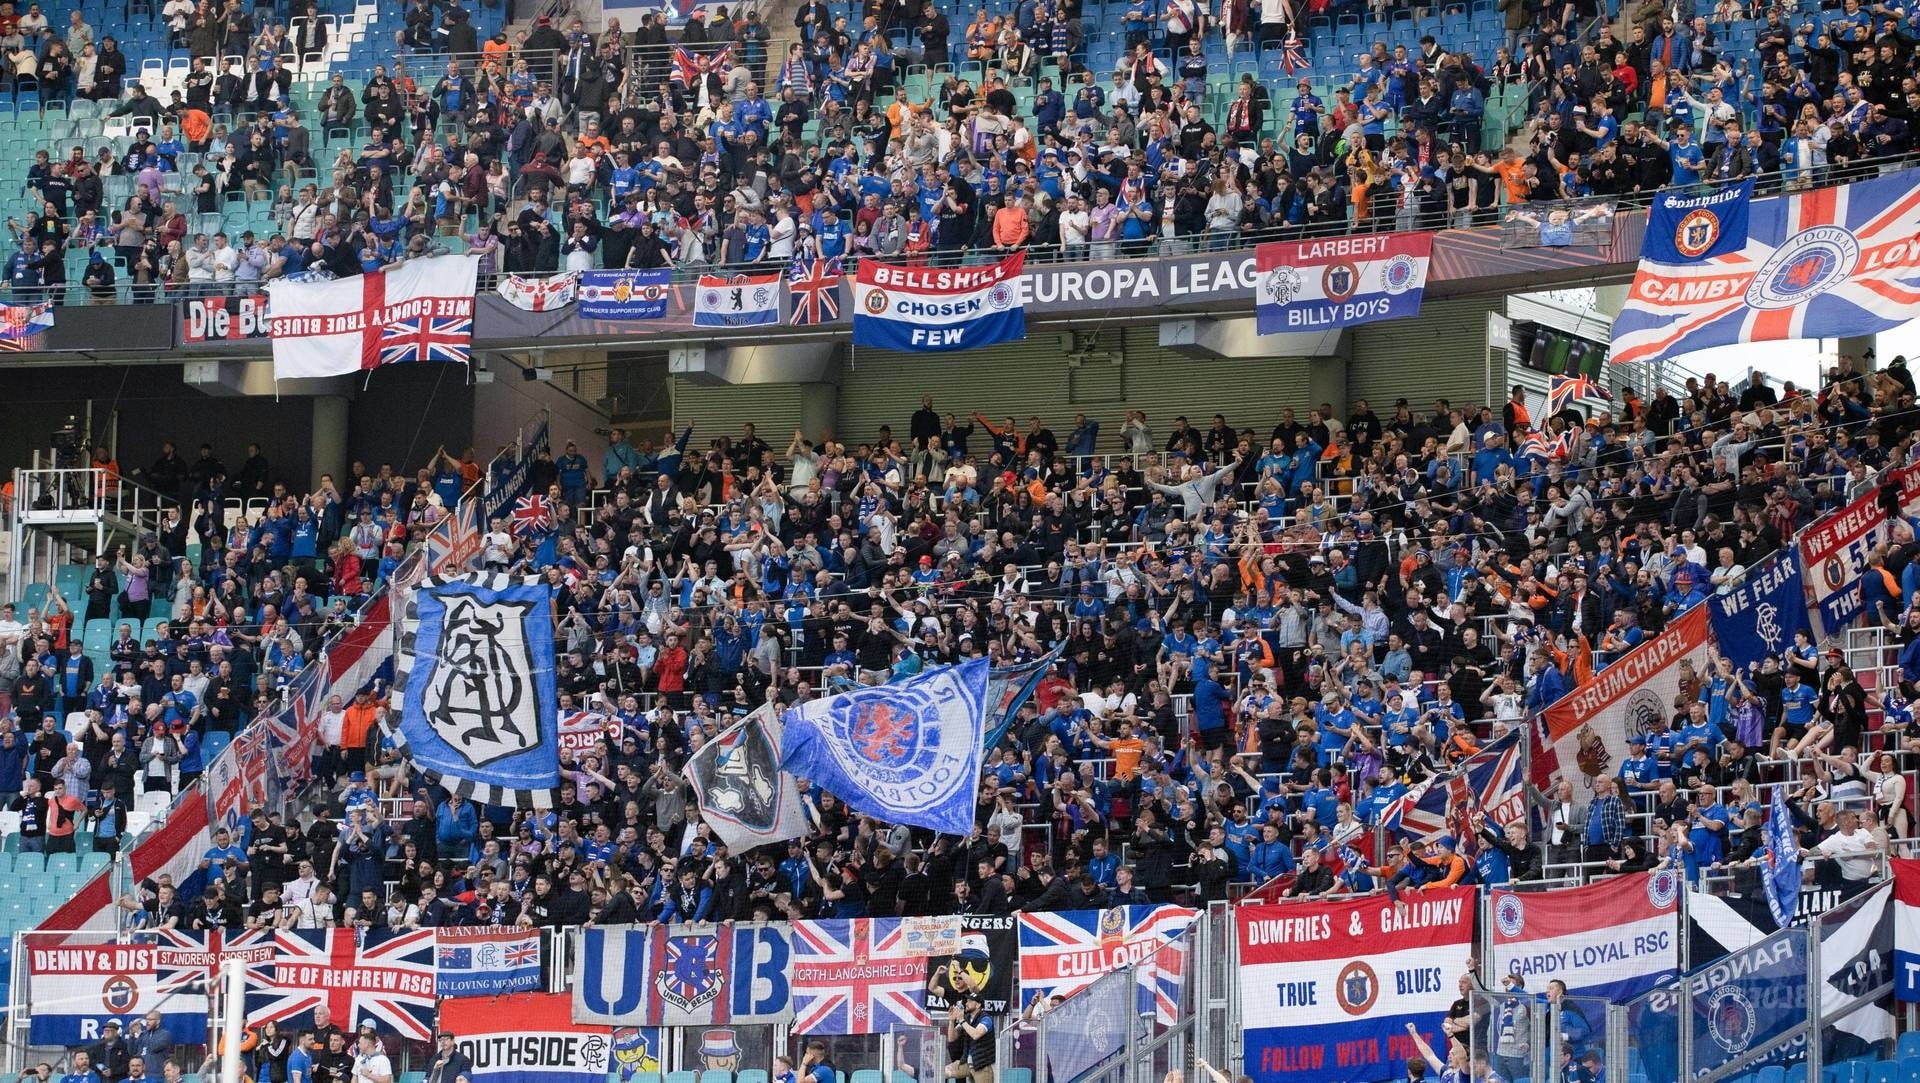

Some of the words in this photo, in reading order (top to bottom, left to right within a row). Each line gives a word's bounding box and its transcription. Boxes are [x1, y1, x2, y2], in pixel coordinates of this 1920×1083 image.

[1298, 236, 1390, 260] LARBERT
[1796, 229, 1855, 260] FOOTBALL
[874, 266, 1006, 290] BELLSHILL
[1020, 268, 1159, 304] EUROPA
[1170, 258, 1256, 296] LEAG
[1640, 277, 1747, 302] CAMBY
[189, 300, 230, 338] Die
[239, 299, 271, 334] Bu
[373, 301, 432, 326] COUNTY
[437, 300, 470, 316] WEE
[897, 298, 981, 317] CHOSEN
[1288, 304, 1341, 326] BILLY
[1344, 298, 1390, 321] BOYS
[273, 318, 321, 336] BLUES
[327, 312, 366, 332] TRUE
[911, 328, 965, 346] FEW
[485, 464, 527, 516] BALLINGRY
[1806, 534, 1833, 557] WE
[1720, 588, 1750, 618] WE
[1752, 557, 1797, 602] FEAR
[1828, 589, 1862, 620] THE
[1571, 629, 1688, 720] DRUMCHAPEL
[557, 719, 621, 748] CRRICK
[1794, 890, 1842, 917] LLANT
[438, 927, 471, 937] ALAN
[961, 917, 1014, 930] NGERS
[1249, 914, 1331, 945] DUMFRIES
[1349, 911, 1364, 937] &
[1381, 898, 1463, 933] GALLOWAY
[35, 950, 98, 971] DENNY
[98, 952, 111, 970] &
[161, 952, 171, 963] ST
[173, 952, 216, 966] ANDREWS
[218, 950, 253, 962] CHOSEN
[255, 949, 272, 962] FEW
[1509, 952, 1567, 976] GARDY
[1573, 941, 1629, 968] LOYAL
[1635, 931, 1669, 956] RSC
[300, 967, 319, 985] OF
[322, 969, 398, 990] RENFREW
[399, 971, 431, 996] RSC
[438, 981, 448, 989] IN
[450, 979, 490, 991] LOVING
[492, 974, 540, 989] MEMORY
[583, 928, 645, 1016] U
[732, 926, 790, 1016] B
[828, 964, 897, 981] LANCASHIRE
[663, 988, 689, 1009] UNION
[691, 987, 717, 1008] BEARS
[1277, 981, 1317, 1007] TRUE
[1396, 967, 1441, 995] BLUES
[983, 1000, 1007, 1012] EW
[456, 1036, 577, 1067] OUTHSIDE
[1261, 1044, 1325, 1072] FOLLOW
